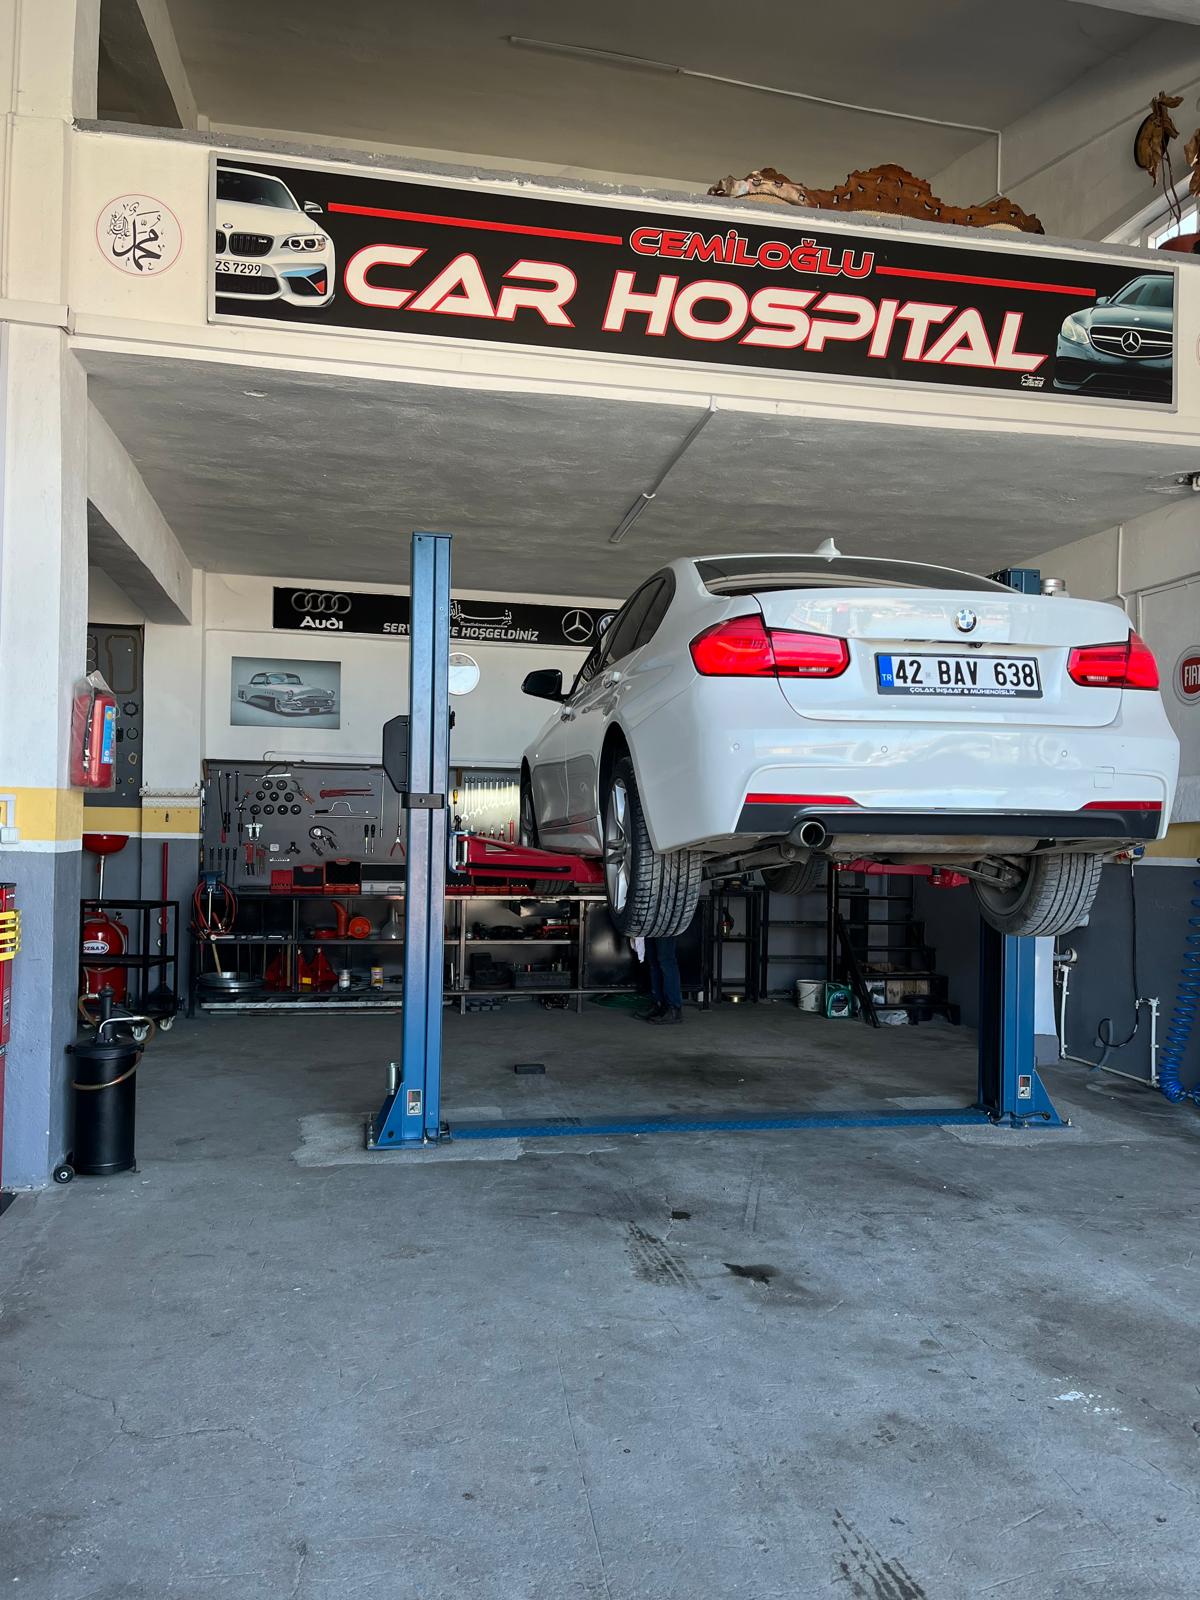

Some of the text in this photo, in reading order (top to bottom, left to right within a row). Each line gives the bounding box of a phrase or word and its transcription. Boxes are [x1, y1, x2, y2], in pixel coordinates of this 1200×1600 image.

[629, 226, 875, 280] CEMİLOĞLU
[233, 263, 261, 275] 7299
[343, 243, 1049, 373] CAR HOSPITAL
[300, 615, 344, 630] Audi
[461, 627, 540, 641] HOŞGELDİNİZ
[881, 673, 893, 681] TR
[895, 659, 1035, 688] 42 BAV 638
[1184, 664, 1200, 687] FIA
